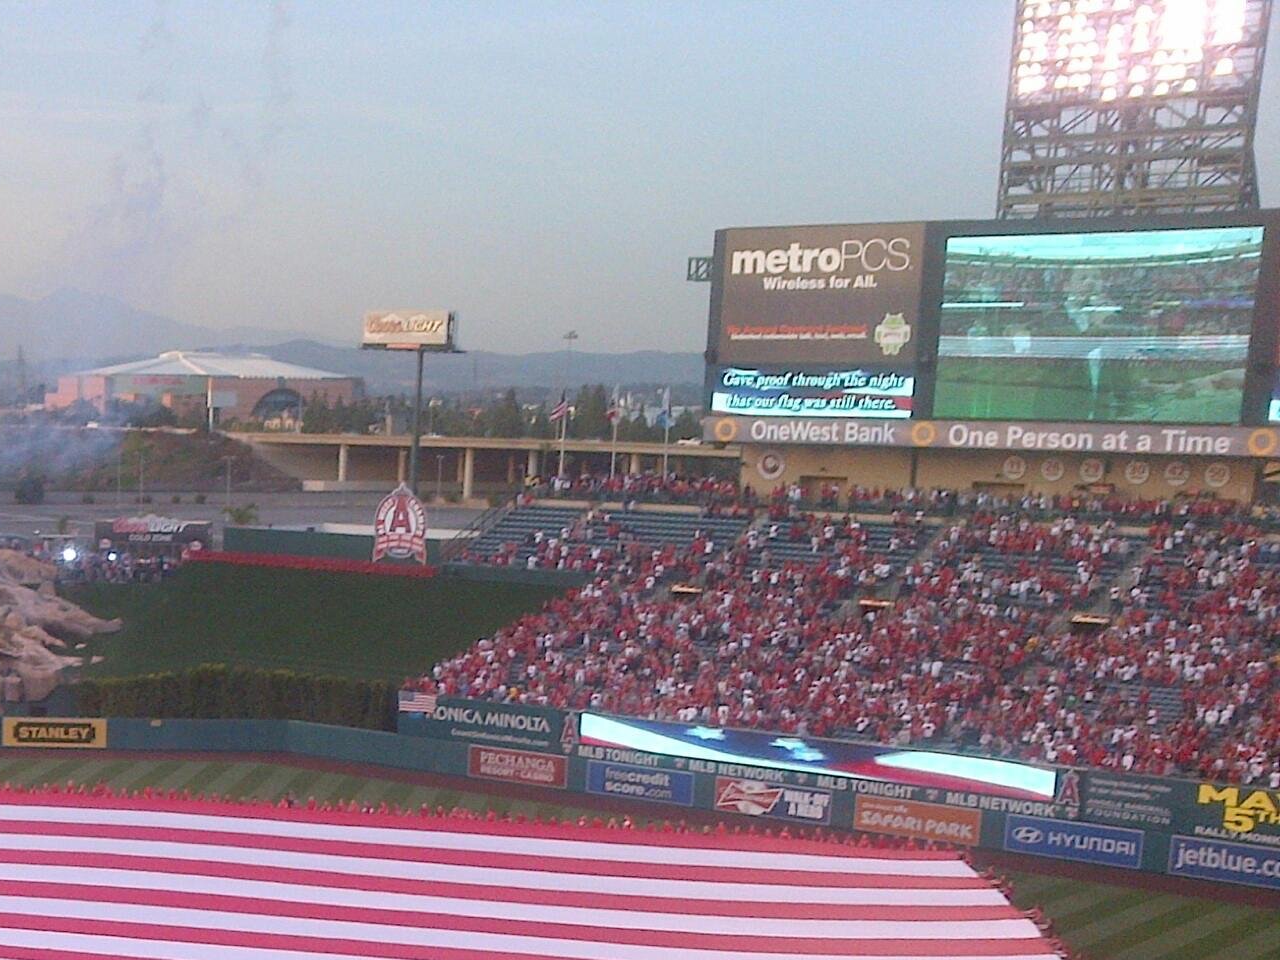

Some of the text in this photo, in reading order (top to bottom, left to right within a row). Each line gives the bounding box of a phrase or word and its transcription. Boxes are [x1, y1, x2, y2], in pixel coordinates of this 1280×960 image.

[732, 238, 910, 274] metroPCS
[764, 277, 826, 290] Wireless
[830, 275, 851, 288] for
[723, 373, 753, 387] Gave
[756, 372, 792, 390] proof
[792, 372, 841, 390] through
[843, 373, 866, 387] the
[727, 394, 752, 408] that
[756, 398, 776, 408] our
[778, 393, 801, 411] flag
[805, 398, 827, 409] was
[829, 395, 856, 409] still
[751, 420, 895, 443] OneWest Bank
[948, 424, 1231, 454] One Person at a Time
[18, 726, 88, 739] STANLEY
[484, 712, 551, 732] MINOLTA
[480, 751, 554, 772] PECHANGA
[578, 745, 659, 766] MLB TONIGHT
[689, 759, 784, 782] MLB NETWORK
[605, 781, 672, 799] score.com
[817, 775, 913, 799] MLB TONIGHT
[946, 792, 1055, 818] MLB NETWORK
[862, 811, 972, 839] SAFARI PARK
[1048, 832, 1136, 855] HYUNDAI
